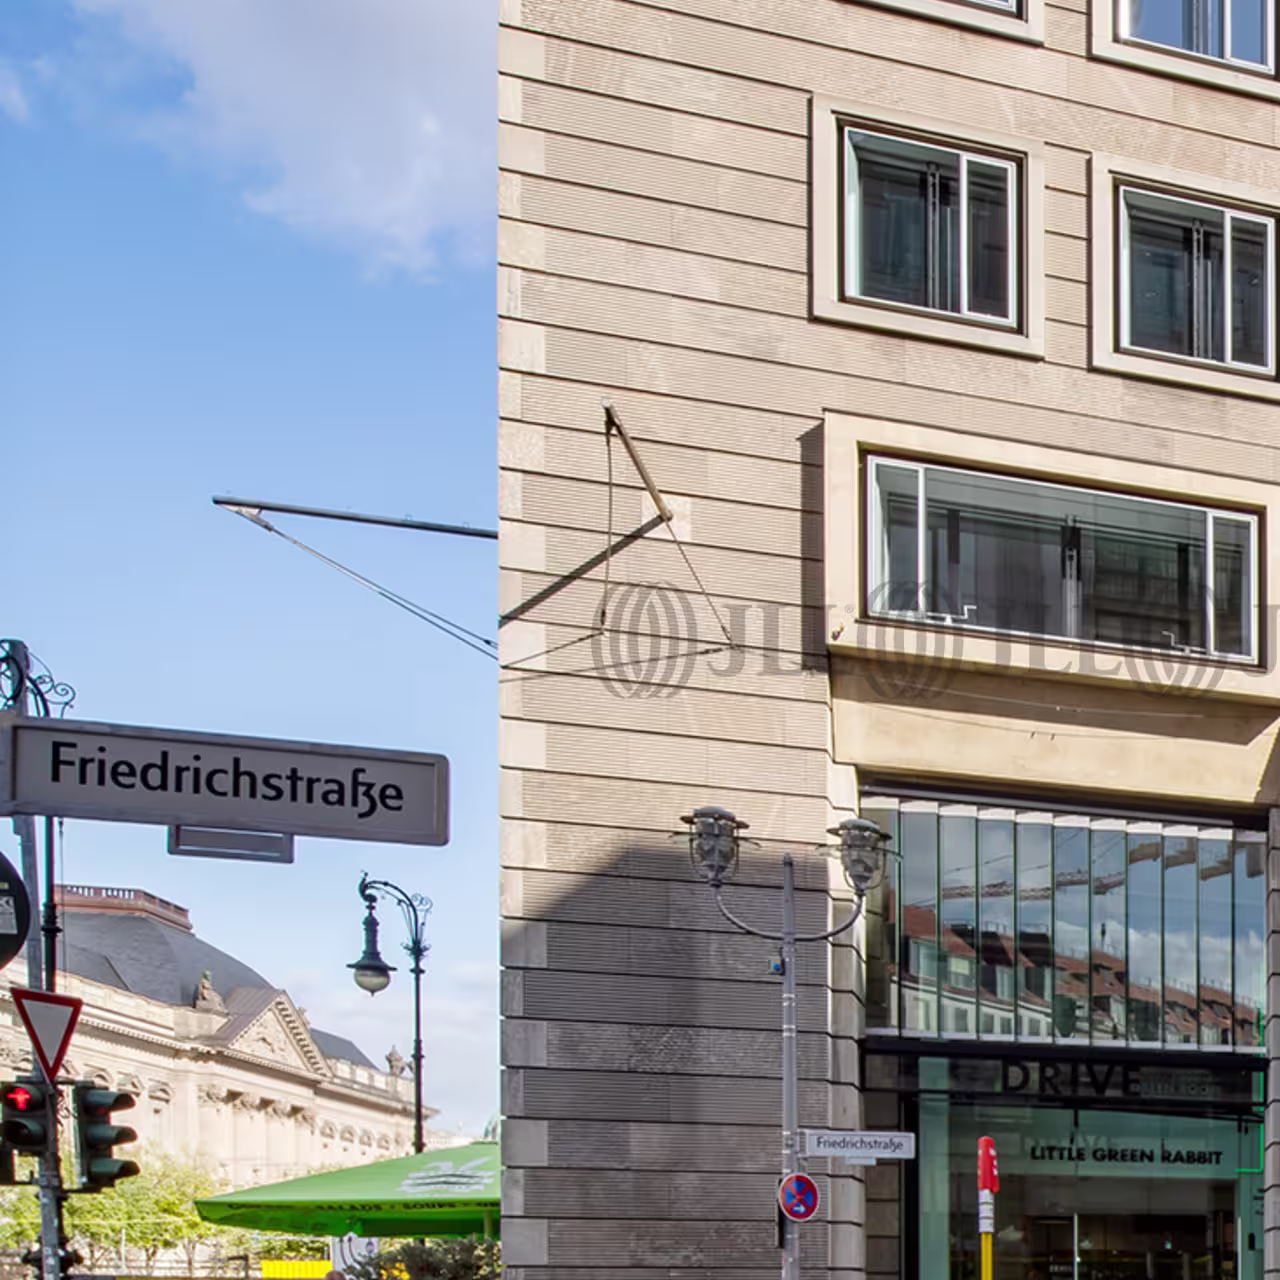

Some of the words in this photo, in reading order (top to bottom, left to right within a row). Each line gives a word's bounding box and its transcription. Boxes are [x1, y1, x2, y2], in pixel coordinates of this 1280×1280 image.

[50, 740, 404, 819] Friedrichstraße
[1002, 1060, 1142, 1097] DRIVE
[816, 1135, 904, 1153] Friedrichstraße
[1030, 1145, 1085, 1162] LITTLE
[1092, 1147, 1154, 1163] GREEN
[1161, 1150, 1223, 1165] RABBIT
